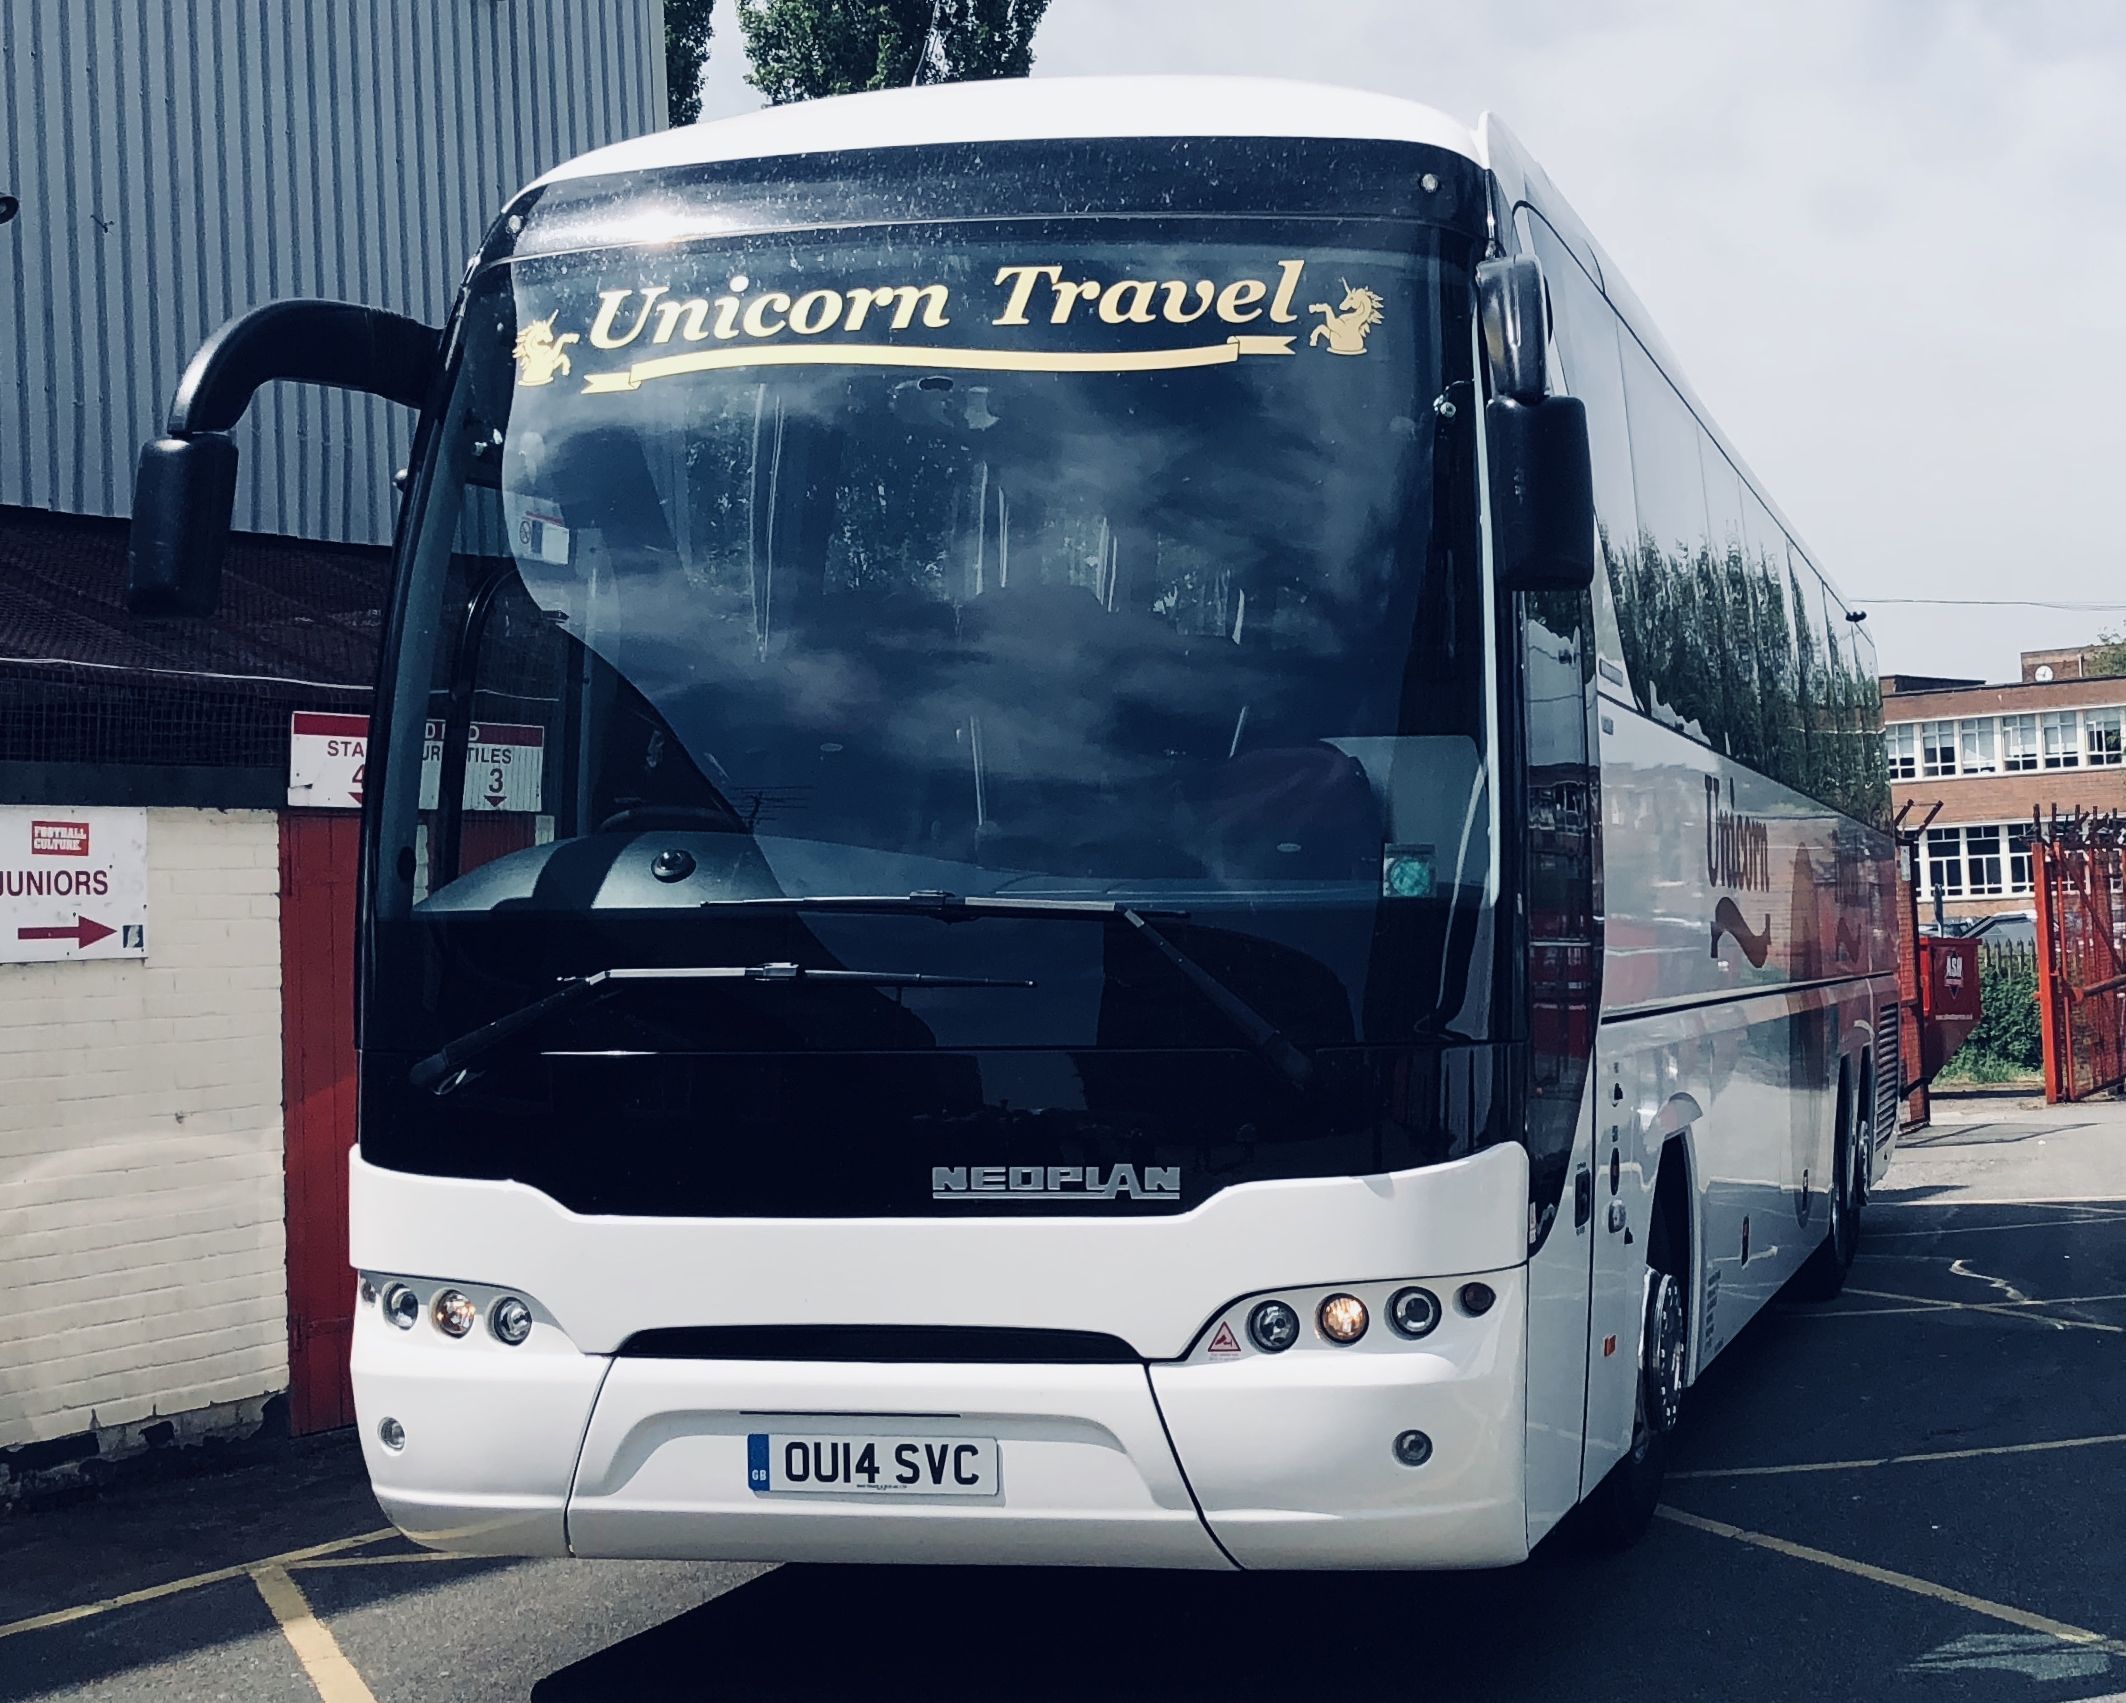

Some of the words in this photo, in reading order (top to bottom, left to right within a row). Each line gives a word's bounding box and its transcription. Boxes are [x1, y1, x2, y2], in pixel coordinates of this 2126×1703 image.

[589, 275, 950, 349] Unicorn
[992, 260, 1304, 325] Travel
[327, 740, 365, 758] STA
[489, 768, 504, 793] 3
[34, 826, 87, 839] FOOTBALL
[34, 838, 82, 851] CULTURE
[1705, 774, 1769, 893] Unicorn
[932, 1163, 1181, 1200] NEOPLAN
[752, 1469, 767, 1481] GB
[895, 1443, 980, 1485] SVC
